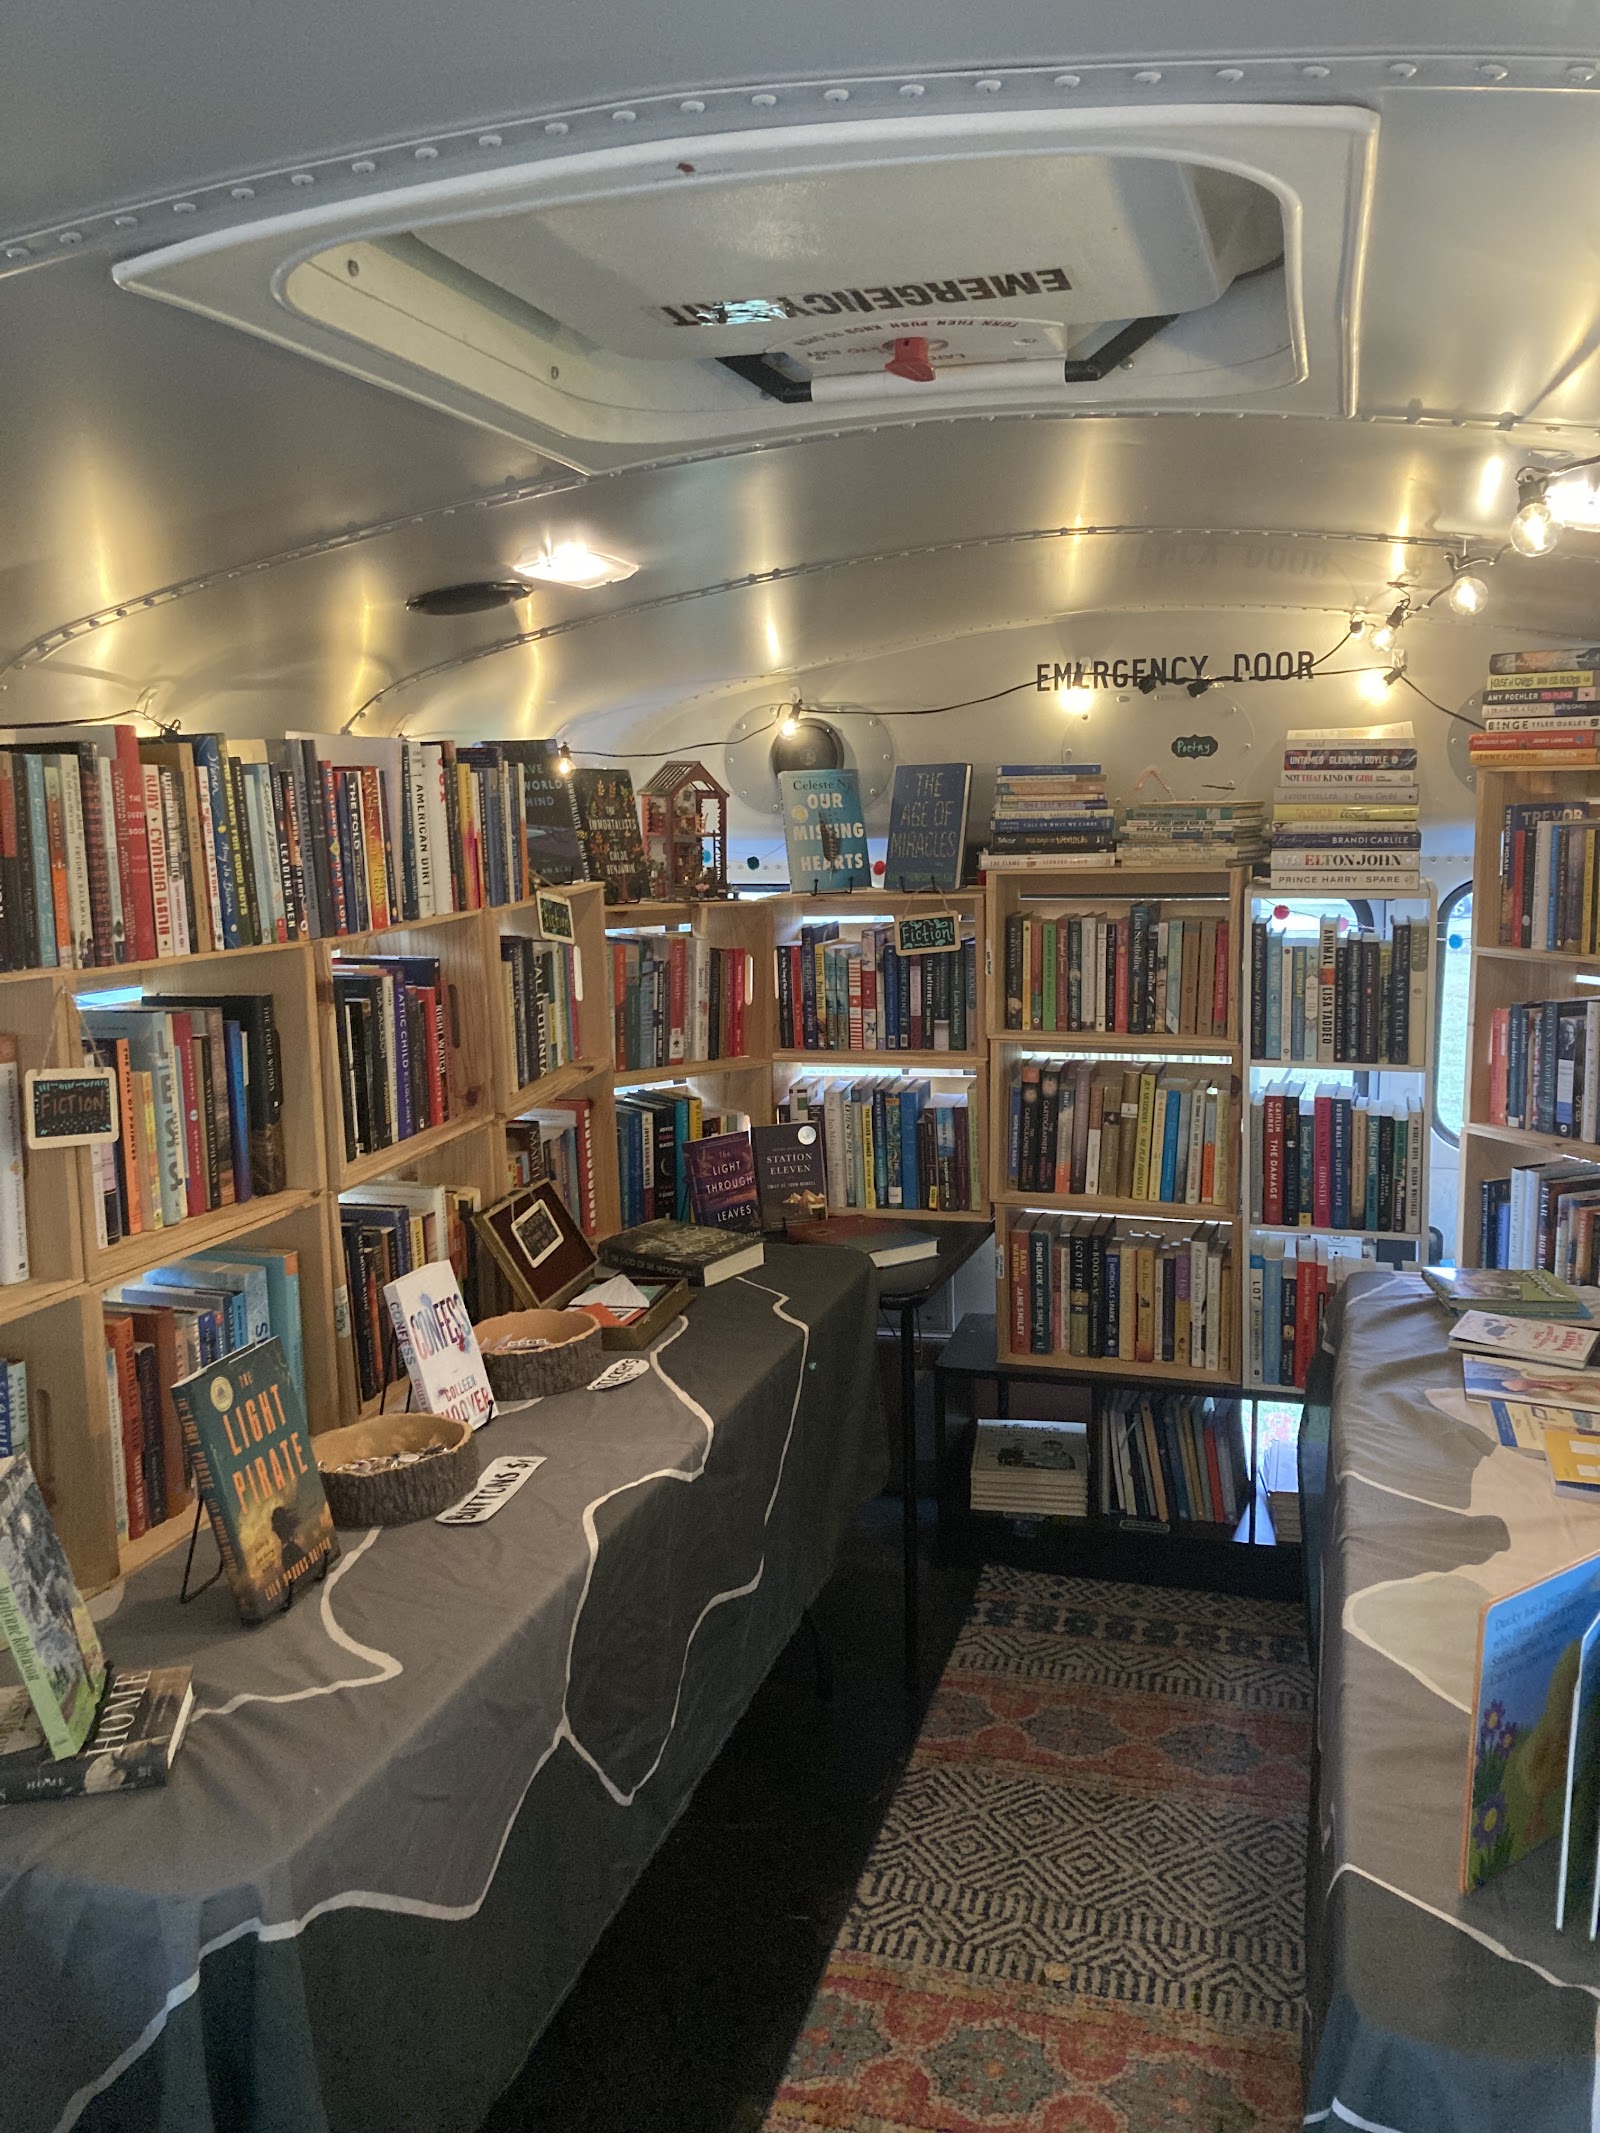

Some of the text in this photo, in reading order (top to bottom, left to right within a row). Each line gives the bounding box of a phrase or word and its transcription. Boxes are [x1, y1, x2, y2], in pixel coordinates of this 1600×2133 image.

[890, 320, 928, 329] PUSH
[936, 319, 974, 328] THEN
[1036, 651, 1316, 692] EMERGENCY DOOR
[1488, 692, 1538, 702] AMY POEHLER
[1290, 755, 1387, 764] UNTAMED GLENNON DOYLE
[404, 773, 412, 789] Last
[916, 772, 944, 798] THE
[1285, 774, 1374, 782] NOT THAT KIND OF GIRL
[163, 772, 176, 818] FLEISHMAN
[226, 784, 236, 826] HEAVEN
[806, 792, 843, 809] OUR
[166, 820, 175, 828] IS
[349, 782, 360, 850] THE FOLD
[405, 792, 413, 835] Romantics
[901, 800, 954, 827] AGE OF
[415, 784, 430, 887] AMERICAN DIRT
[888, 832, 956, 859] MIRACLES
[1370, 836, 1409, 844] CARLILE
[150, 828, 167, 892] CYNTHIA
[168, 841, 179, 877] TROUBLE
[235, 853, 244, 884] GOOD
[800, 853, 864, 872] HEARTS
[1305, 854, 1401, 866] ELTON JOHN
[280, 843, 296, 928] LEADING MEN
[338, 887, 344, 901] WE
[238, 887, 248, 916] BOYS
[1133, 913, 1143, 972] Lisa Scottoline
[1254, 935, 1262, 969] Elizabeth
[804, 955, 813, 996] THERAPIST
[926, 973, 934, 1005] leftovers
[1322, 930, 1334, 1044] ANIMAL LISA TADDEO
[398, 994, 407, 1027] ATTIC
[535, 956, 547, 1078] CALIFORNIA
[953, 1008, 961, 1034] Children
[265, 1028, 274, 1055] FOUR
[377, 1010, 387, 1059] JACKSON
[400, 1031, 409, 1068] CHILD
[124, 1071, 132, 1094] FALL
[267, 1059, 276, 1092] WINDS
[1041, 1101, 1049, 1153] CARTOGRAPHERS
[766, 1152, 813, 1164] STATION
[1270, 1140, 1278, 1157] THE
[712, 1160, 740, 1176] LIGHT
[770, 1164, 811, 1176] ELEVEN
[706, 1176, 753, 1194] THROUGH
[717, 1204, 752, 1222] LEAVES
[1075, 1240, 1083, 1312] SCOTT SPENCER
[1092, 1252, 1100, 1277] BOOK
[1194, 1249, 1202, 1280] Elizabeth
[389, 1301, 416, 1366] CONFESS
[410, 1293, 472, 1360] CONFESS
[444, 1374, 477, 1400] COLLEEN
[222, 1383, 288, 1456] LIGHT
[191, 1451, 214, 1490] PIRATE
[232, 1432, 308, 1516] PIRATE
[12, 1632, 40, 1682] Robinson
[85, 1670, 152, 1758] HOME
